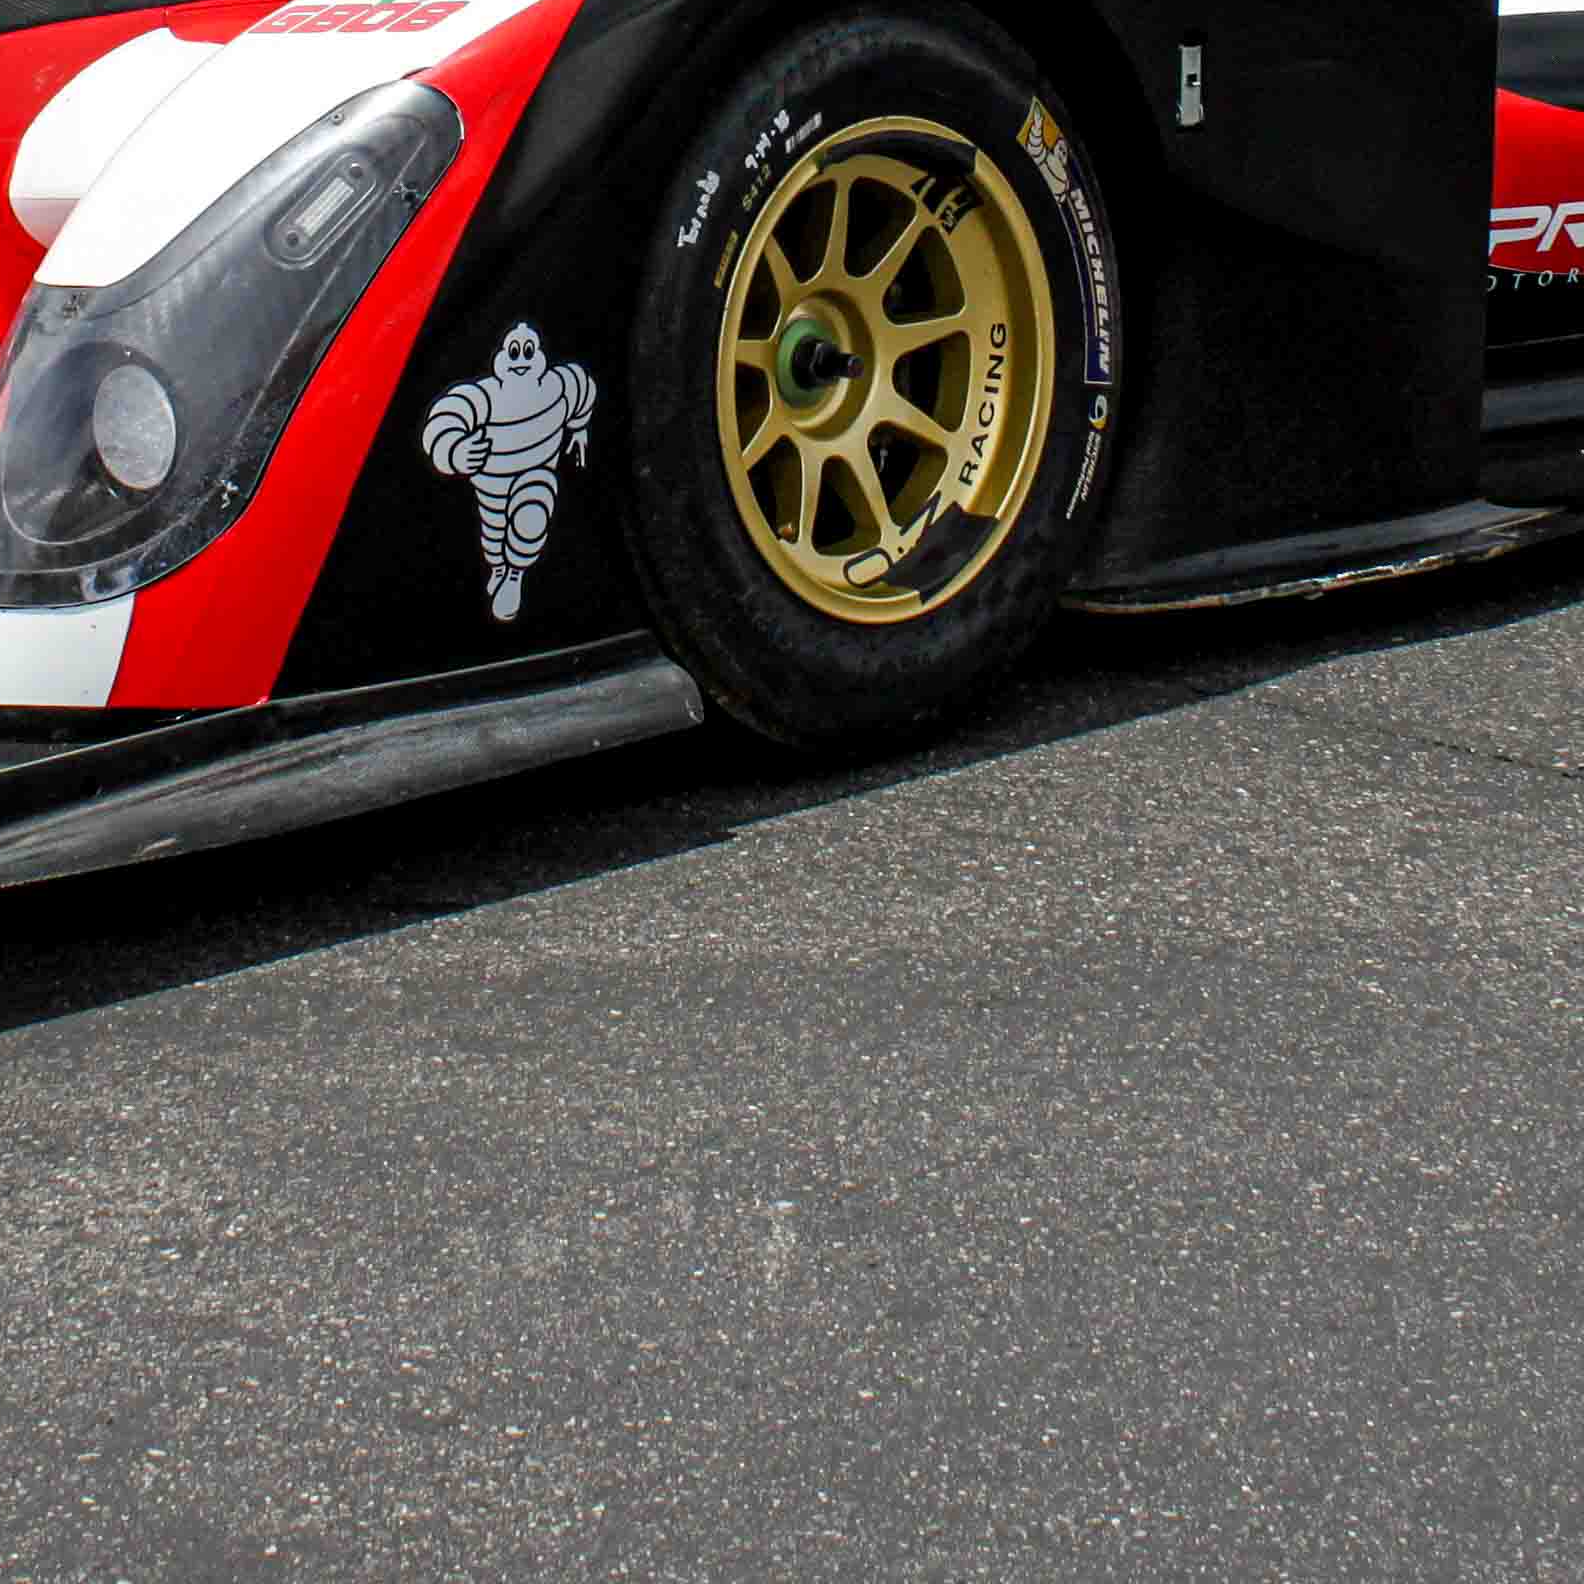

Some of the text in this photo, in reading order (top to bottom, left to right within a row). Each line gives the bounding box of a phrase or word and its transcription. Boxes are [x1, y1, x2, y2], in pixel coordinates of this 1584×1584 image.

[247, 0, 471, 34] GB08
[1069, 186, 1111, 376] MICHELIN
[957, 322, 1007, 487] RACING
